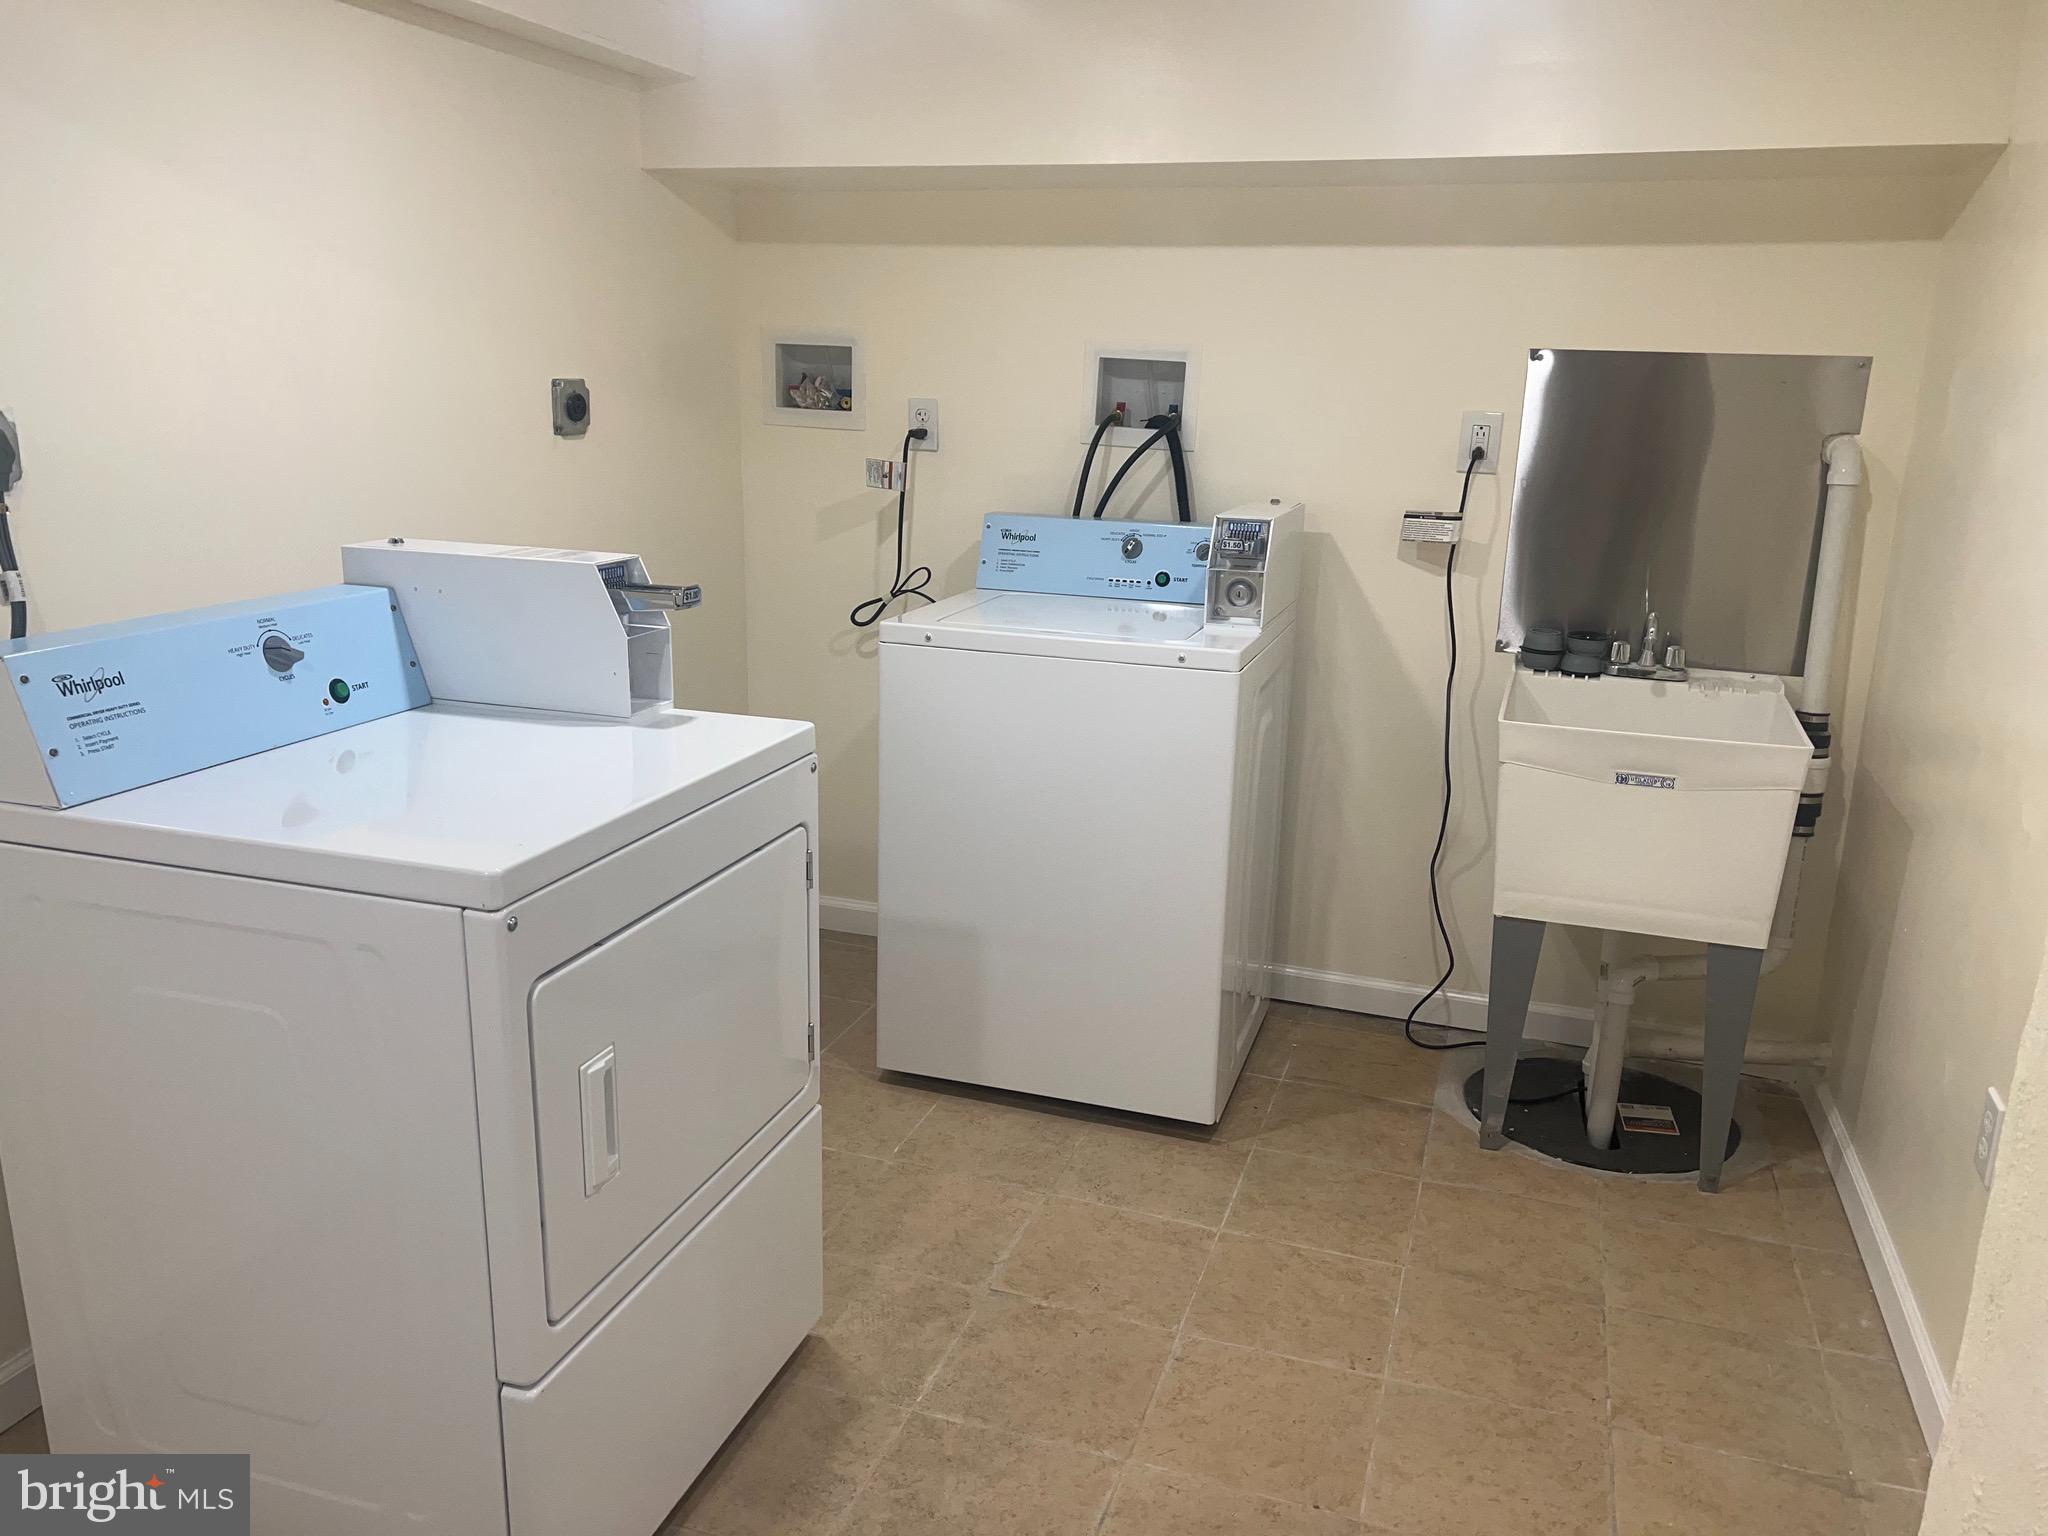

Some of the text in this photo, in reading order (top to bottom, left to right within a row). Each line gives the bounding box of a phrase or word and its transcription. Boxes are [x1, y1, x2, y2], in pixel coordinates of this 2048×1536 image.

[1001, 533, 1037, 543] Whirlpool
[1223, 541, 1242, 549] $1.50
[278, 673, 296, 682] CYCLES
[56, 670, 125, 697] Whirlpool
[351, 681, 369, 692] START
[69, 707, 146, 730] OPERATING INSTRUCTIONS
